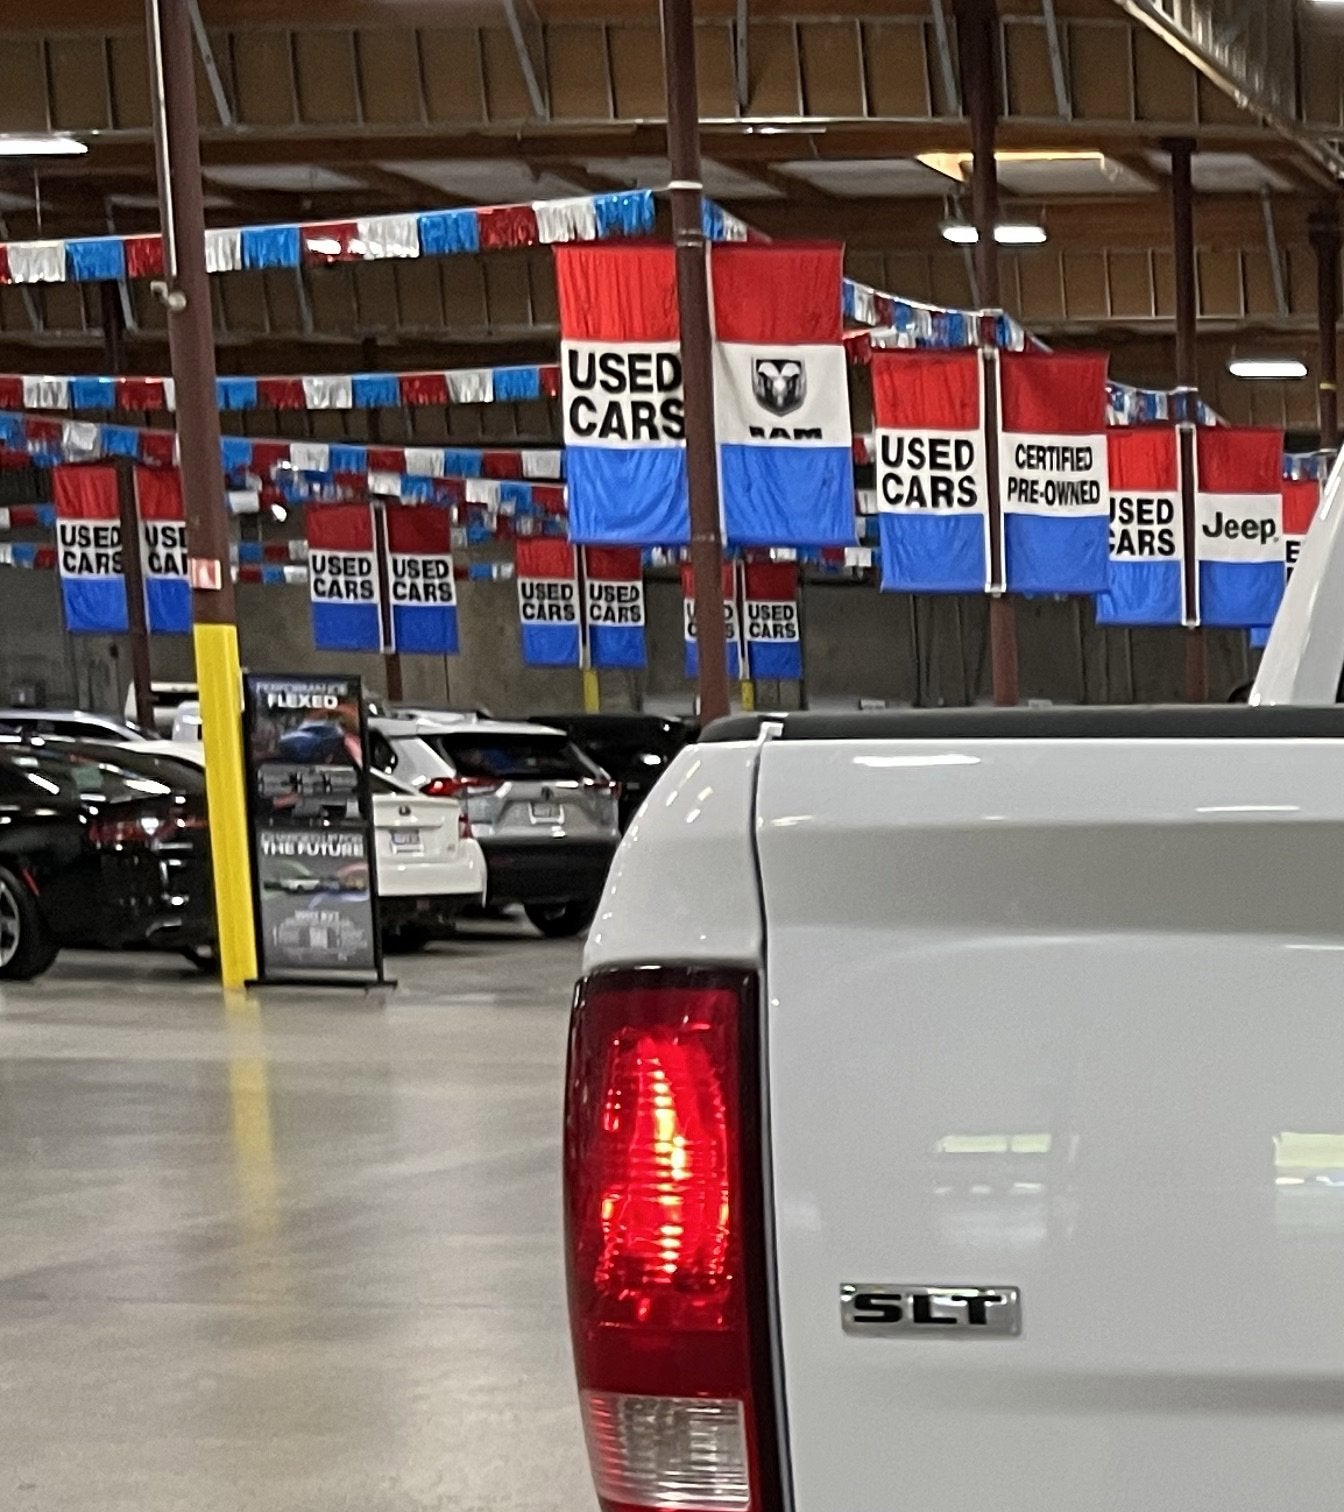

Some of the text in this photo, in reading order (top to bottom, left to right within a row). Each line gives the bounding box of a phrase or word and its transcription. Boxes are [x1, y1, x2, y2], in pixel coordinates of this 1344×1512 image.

[568, 349, 682, 394] USED
[569, 395, 685, 440] CARS
[749, 425, 823, 440] RAM
[881, 435, 975, 471] USED
[1015, 443, 1093, 472] CERTIFIED
[882, 472, 978, 508] CARS
[1007, 476, 1100, 506] PRE-OWNED
[60, 525, 122, 548] USED
[312, 554, 372, 577] USED
[392, 558, 449, 580] USED
[313, 577, 374, 600] CARS
[392, 580, 452, 602] CARS
[521, 582, 573, 601] USED
[589, 583, 640, 603] USED
[522, 602, 575, 621] CARS
[589, 603, 641, 623] CARS
[748, 604, 794, 621] USED
[749, 622, 796, 638] CARS
[853, 1293, 1003, 1325] SLT
